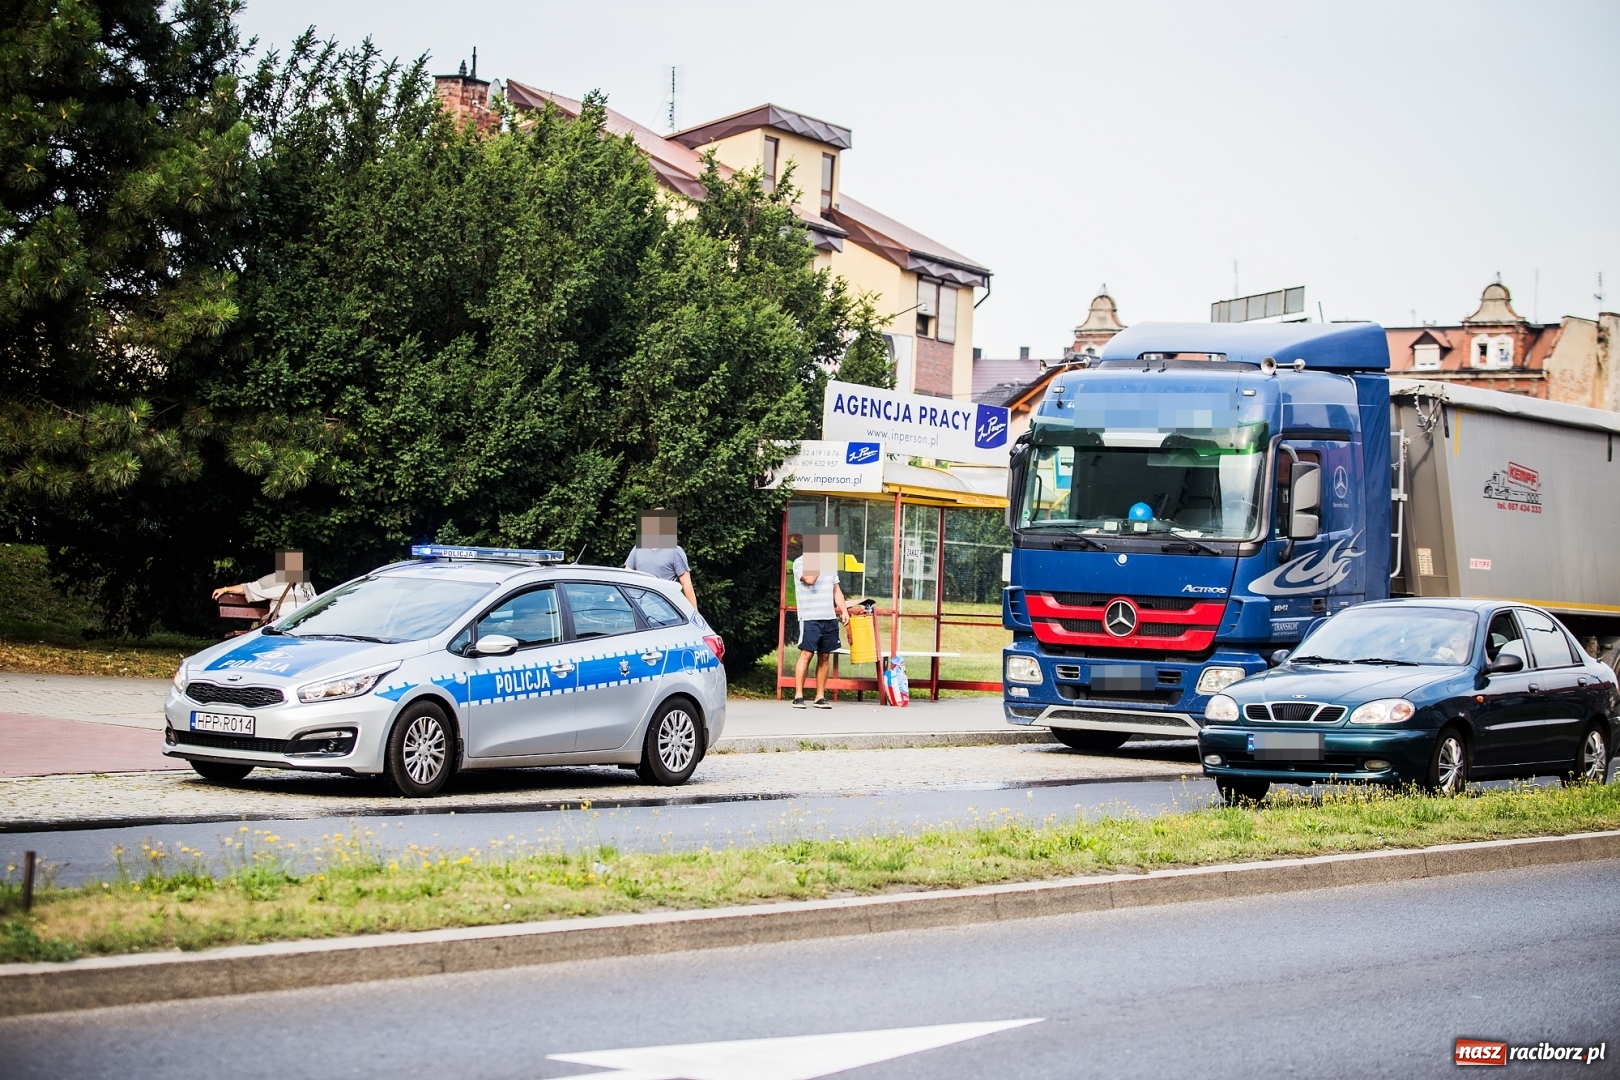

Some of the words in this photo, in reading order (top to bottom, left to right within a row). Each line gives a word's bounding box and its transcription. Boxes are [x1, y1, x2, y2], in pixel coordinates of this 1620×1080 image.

[833, 393, 912, 424] AGENCJA
[919, 406, 972, 431] PRACY
[866, 428, 939, 448] www.inperson.pl
[1509, 466, 1537, 485] KEMPF
[443, 550, 474, 558] POLICJA
[218, 659, 290, 673] POLICJA
[495, 668, 551, 695] POLICJA
